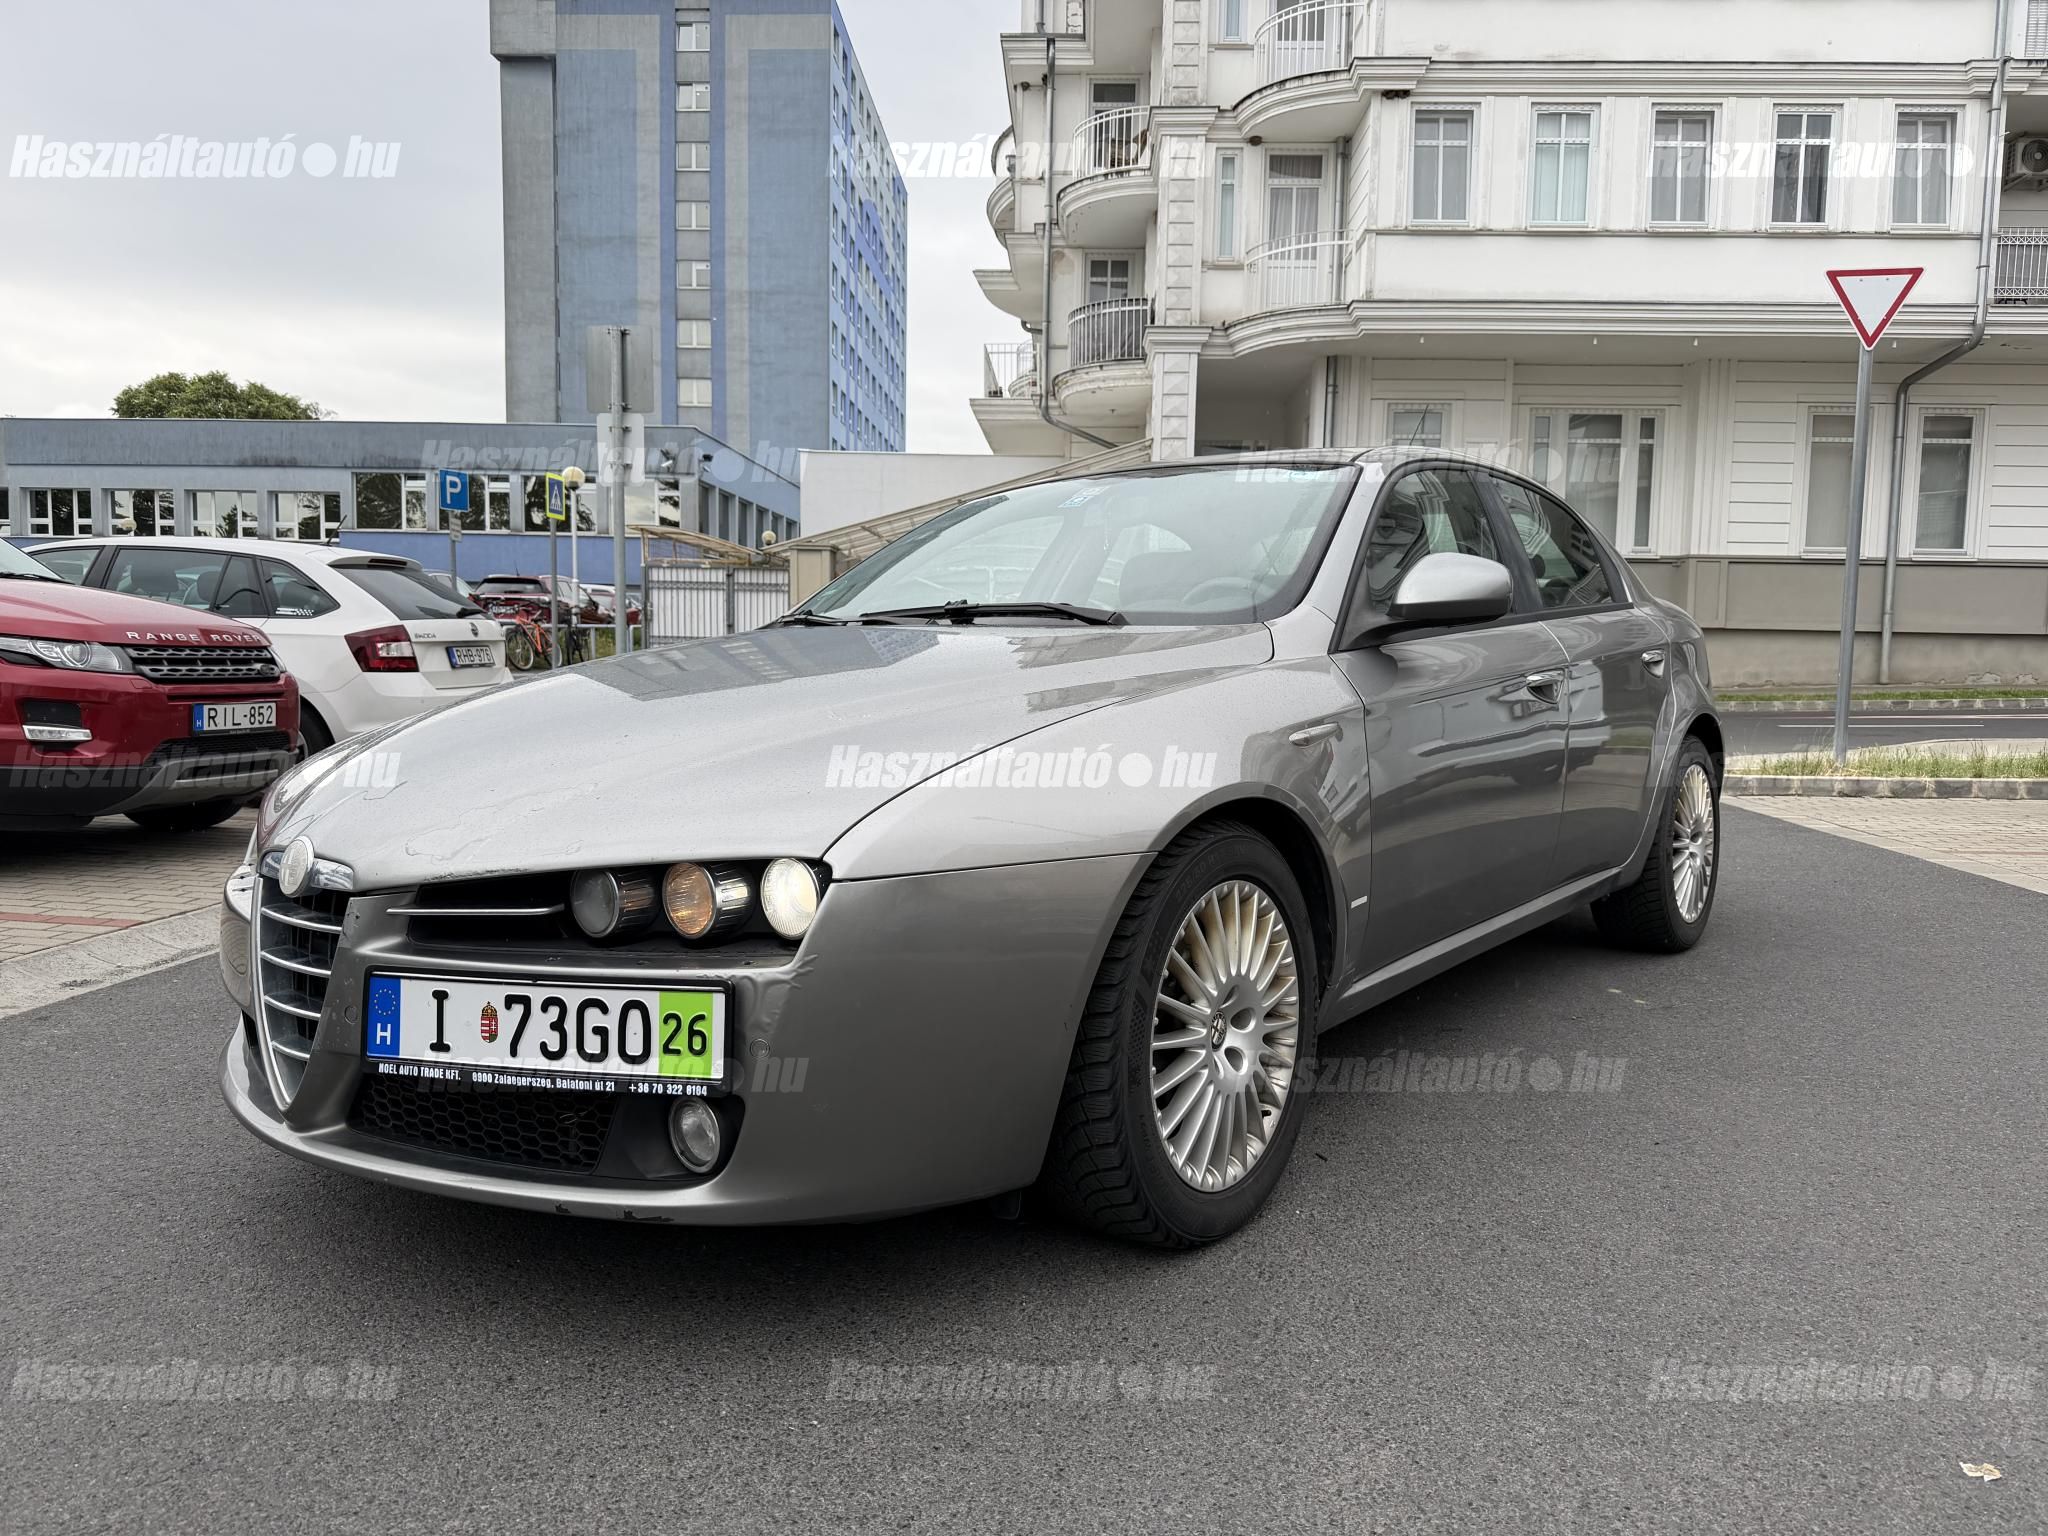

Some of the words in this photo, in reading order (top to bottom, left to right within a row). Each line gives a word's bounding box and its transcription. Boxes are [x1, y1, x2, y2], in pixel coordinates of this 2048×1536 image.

[446, 475, 461, 504] P
[126, 631, 200, 641] RANGE
[210, 634, 262, 643] ROVER
[207, 705, 273, 727] RIL-852
[375, 1022, 392, 1046] H
[429, 989, 451, 1053] I
[661, 1011, 708, 1057] 26
[399, 1064, 418, 1077] AUTO
[420, 1066, 444, 1079] TRADE
[446, 1068, 461, 1081] KFT.
[605, 1081, 615, 1092] 21
[628, 1082, 649, 1093] +36
[652, 1083, 663, 1094] 70
[666, 1084, 683, 1095] 322
